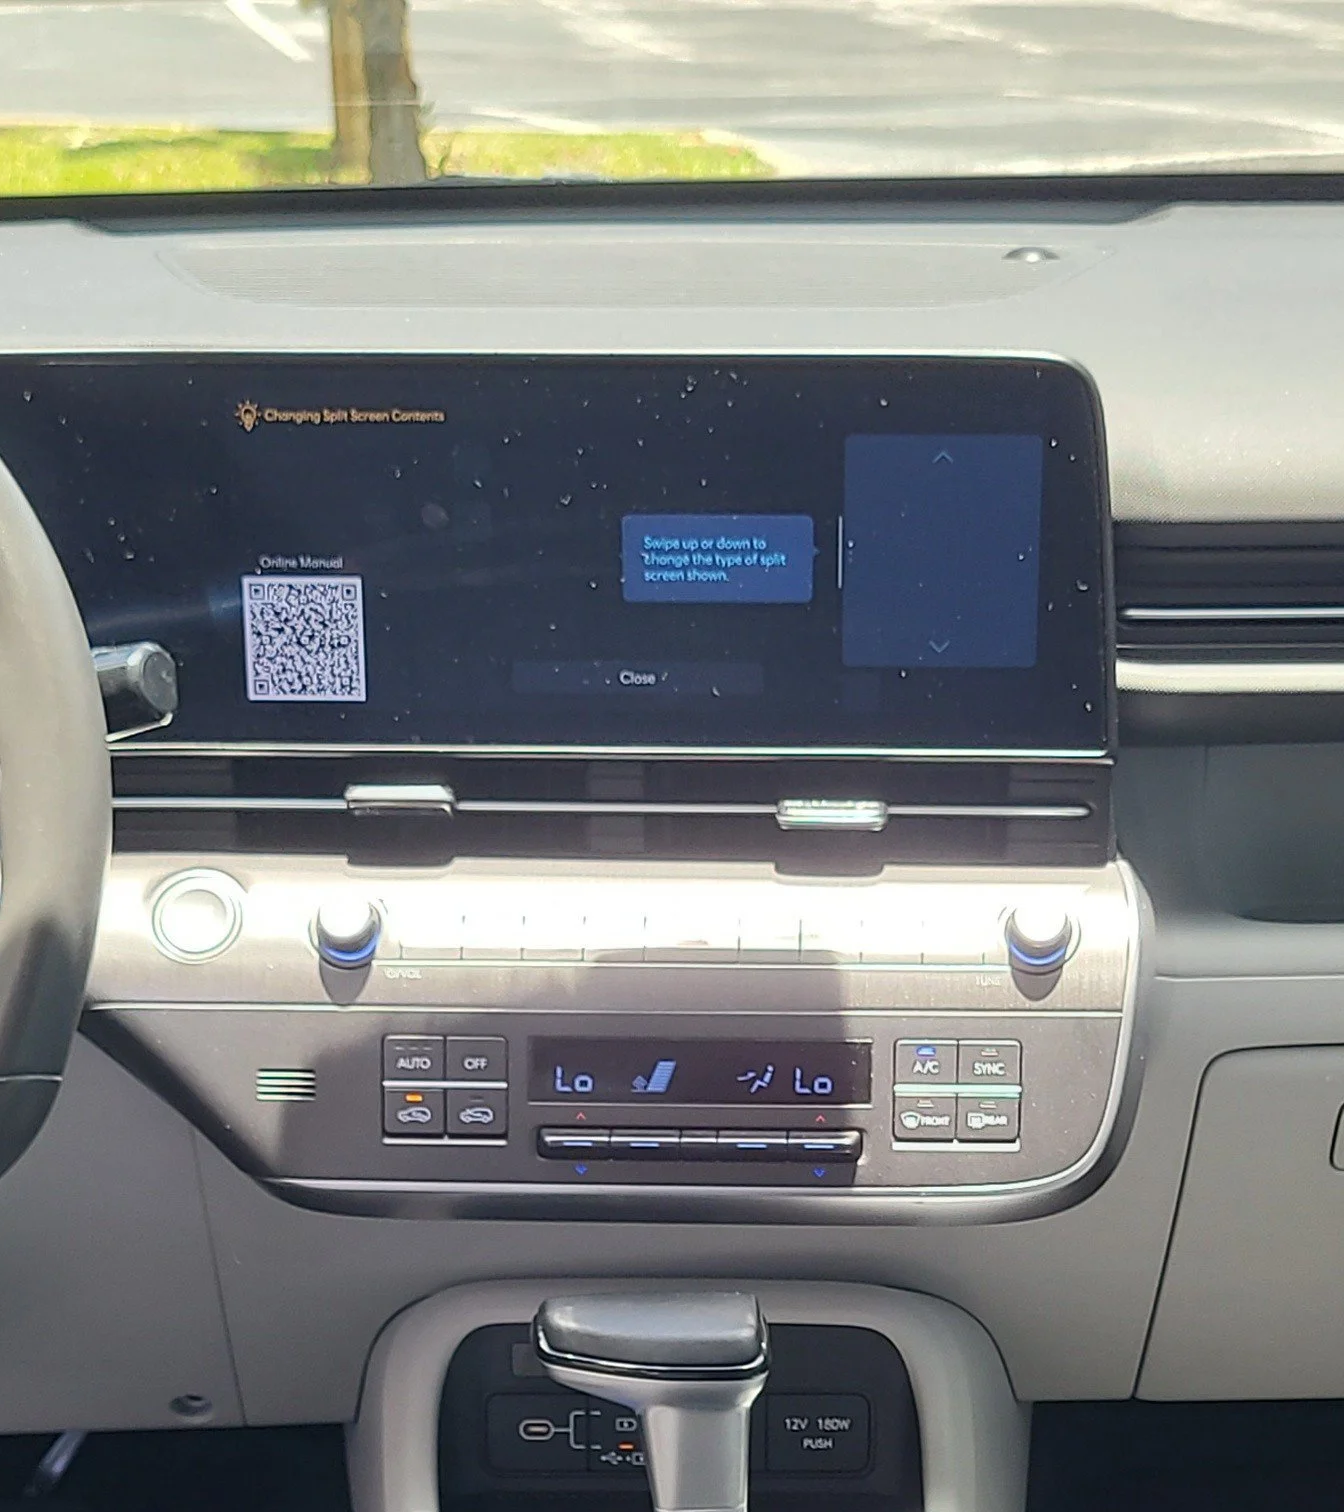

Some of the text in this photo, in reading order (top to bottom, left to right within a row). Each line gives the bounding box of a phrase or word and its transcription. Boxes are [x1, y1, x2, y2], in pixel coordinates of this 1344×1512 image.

[264, 408, 445, 425] Changing Split Screen Contents
[643, 535, 767, 551] Swipe up or down to
[259, 554, 343, 569] Online Manual
[643, 553, 786, 568] change the type of split
[644, 569, 729, 582] screen shown.
[619, 669, 656, 685] Close
[396, 1057, 431, 1069] AUTO
[463, 1057, 488, 1070] OFF
[913, 1060, 940, 1074] A/C
[973, 1062, 1006, 1075] SYNC
[920, 1115, 950, 1126] FRONT
[785, 1418, 852, 1431] 12V 180W
[803, 1438, 833, 1449] PUSH
